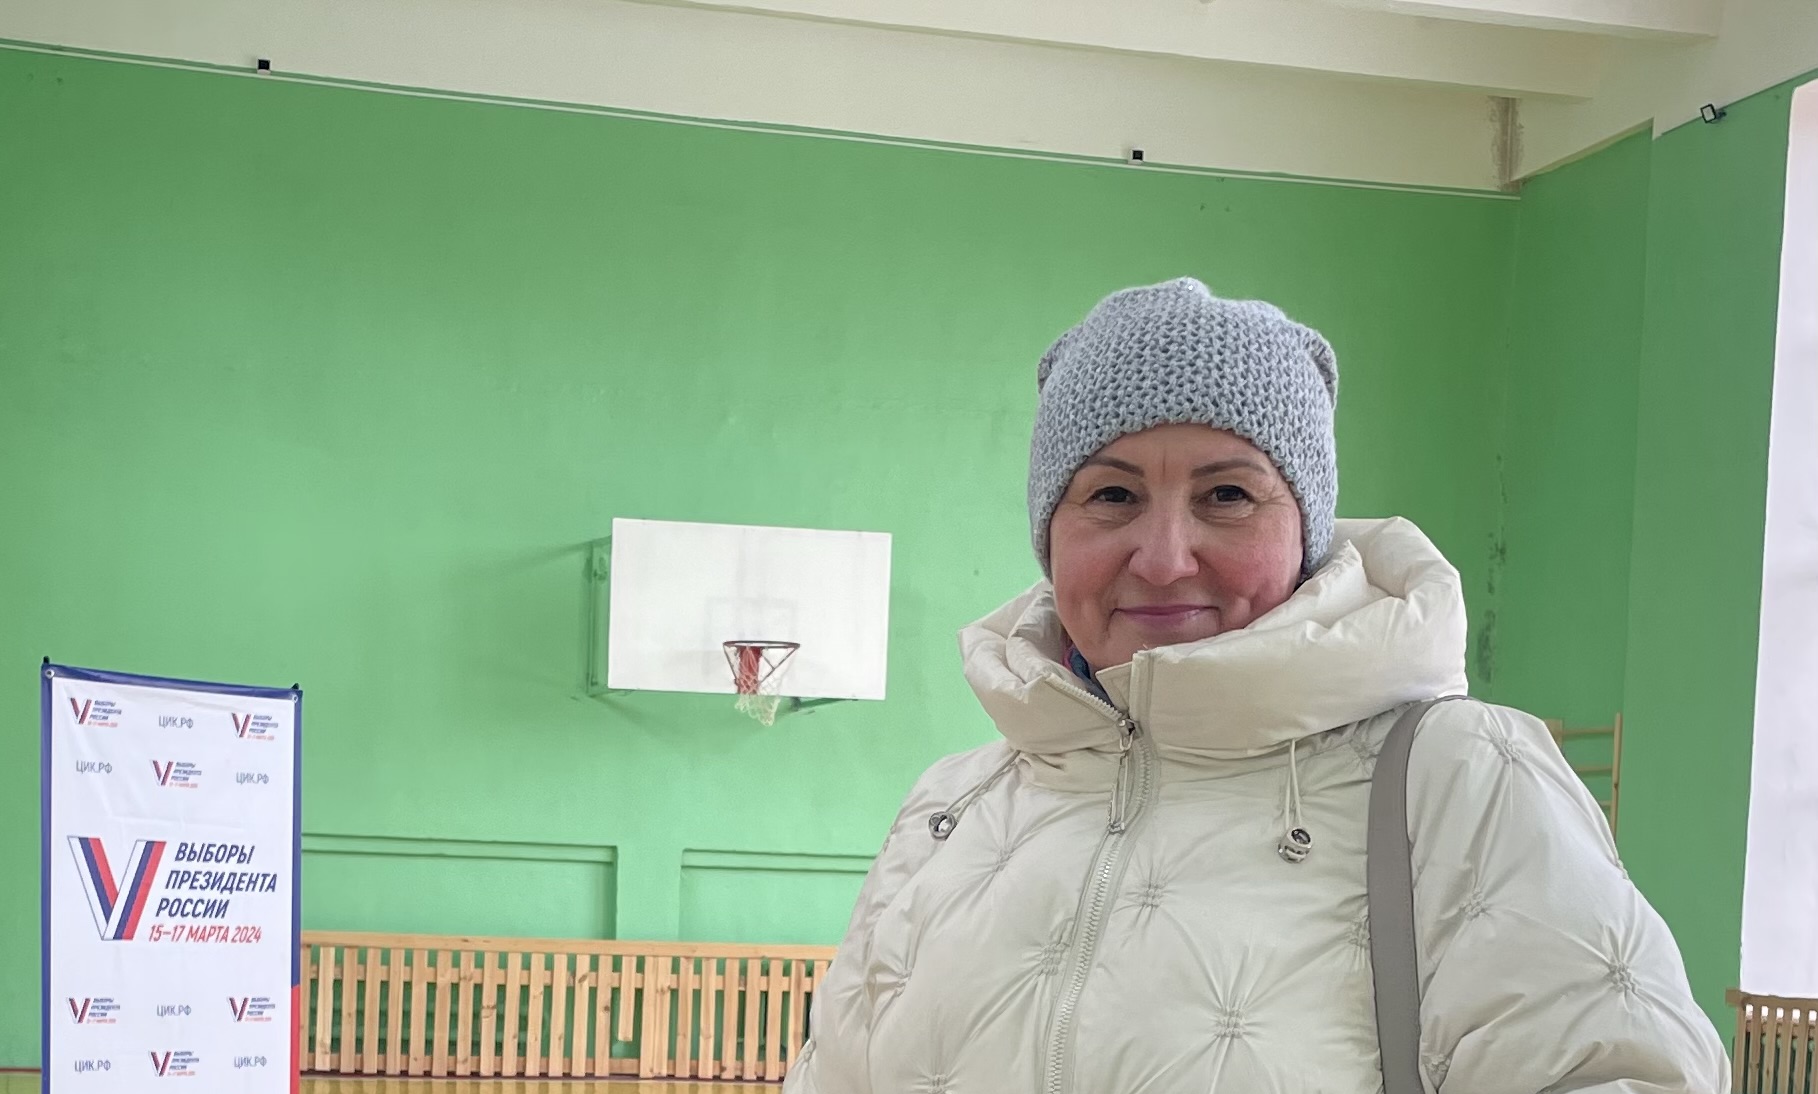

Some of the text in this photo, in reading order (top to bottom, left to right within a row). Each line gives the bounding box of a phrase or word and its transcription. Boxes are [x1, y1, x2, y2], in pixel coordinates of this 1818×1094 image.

[174, 842, 255, 864] ВЫБОРЫ
[165, 870, 278, 894] ПРЕЗИДЕНТА
[155, 898, 230, 919] РОССИИ
[186, 926, 229, 943] МАРТА
[231, 926, 262, 944] 2024
